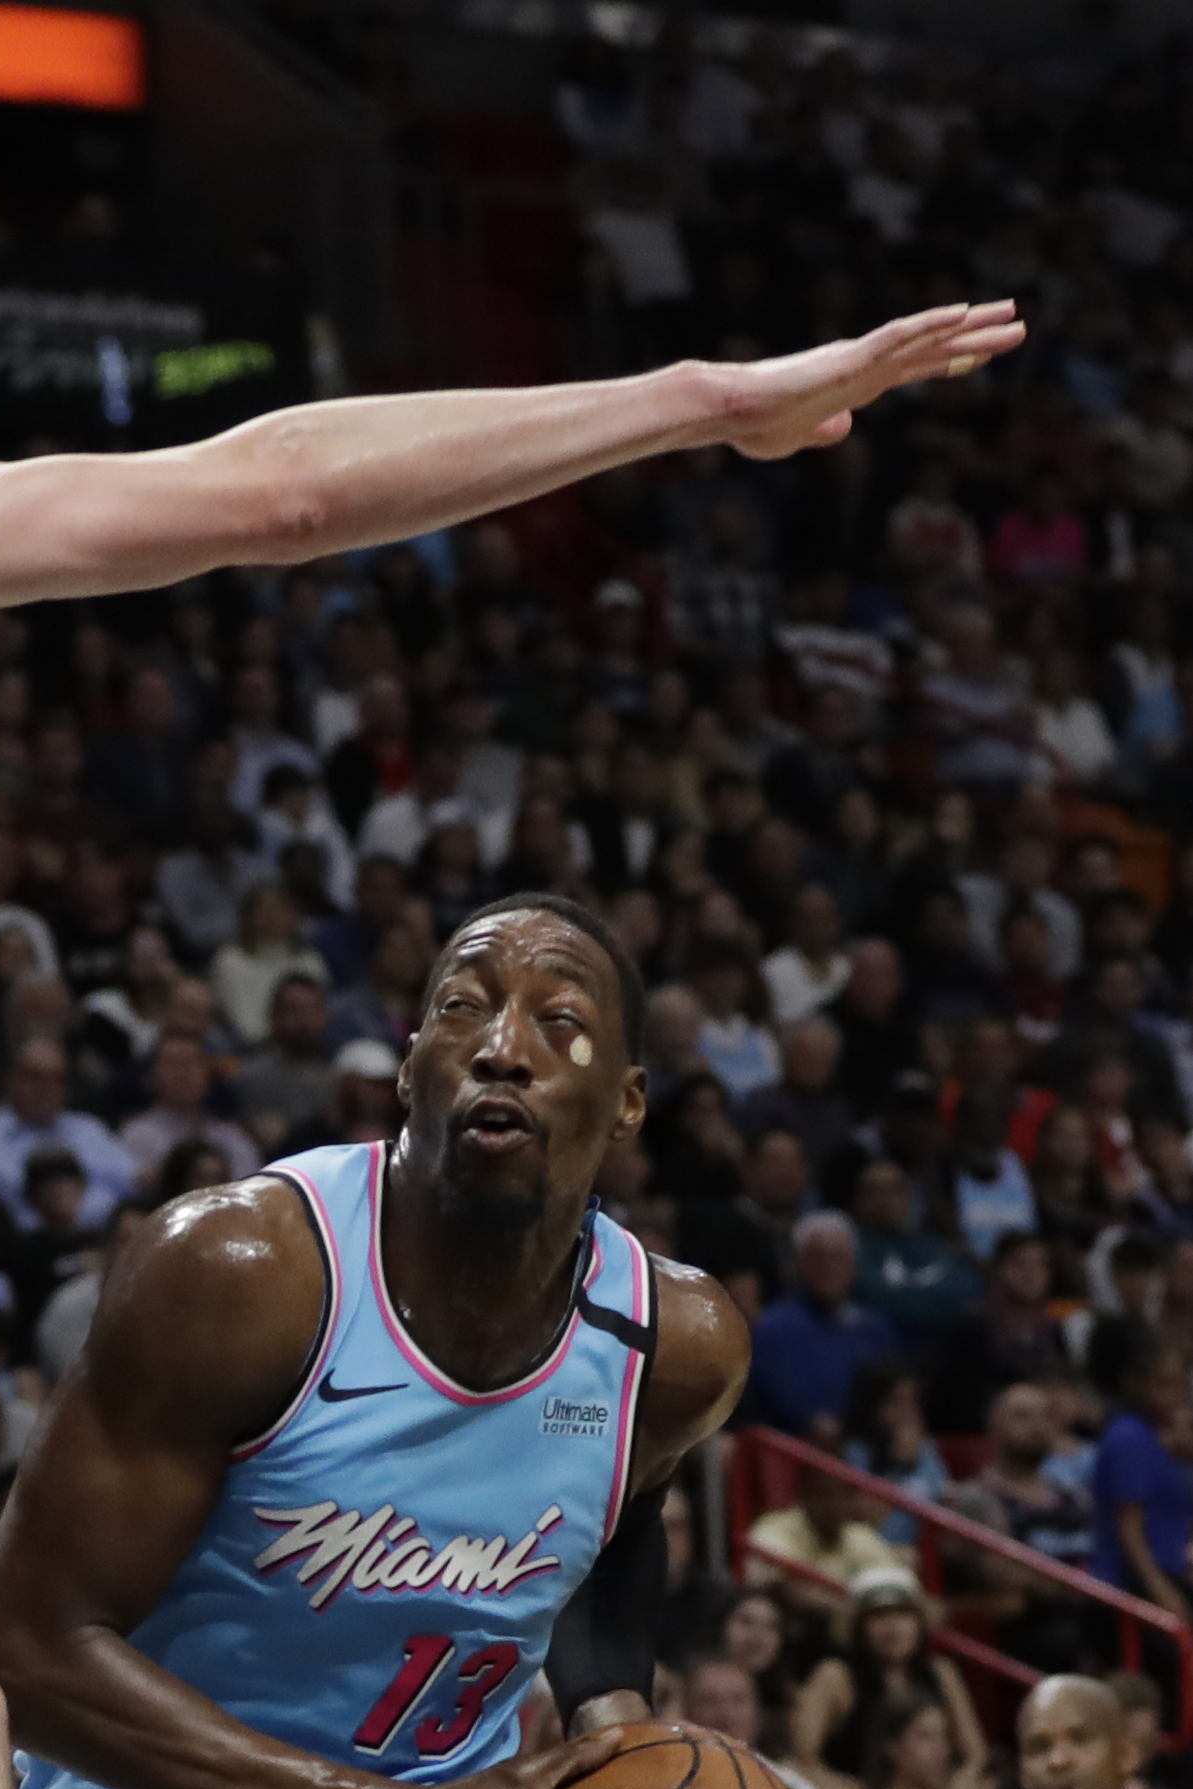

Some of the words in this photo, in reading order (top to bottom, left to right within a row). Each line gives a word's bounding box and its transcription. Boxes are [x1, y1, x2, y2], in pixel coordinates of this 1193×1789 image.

[542, 1422, 604, 1437] SOFTWARE
[543, 1399, 608, 1423] Ultimate
[253, 1500, 563, 1614] Miami
[354, 1634, 519, 1762] 13
